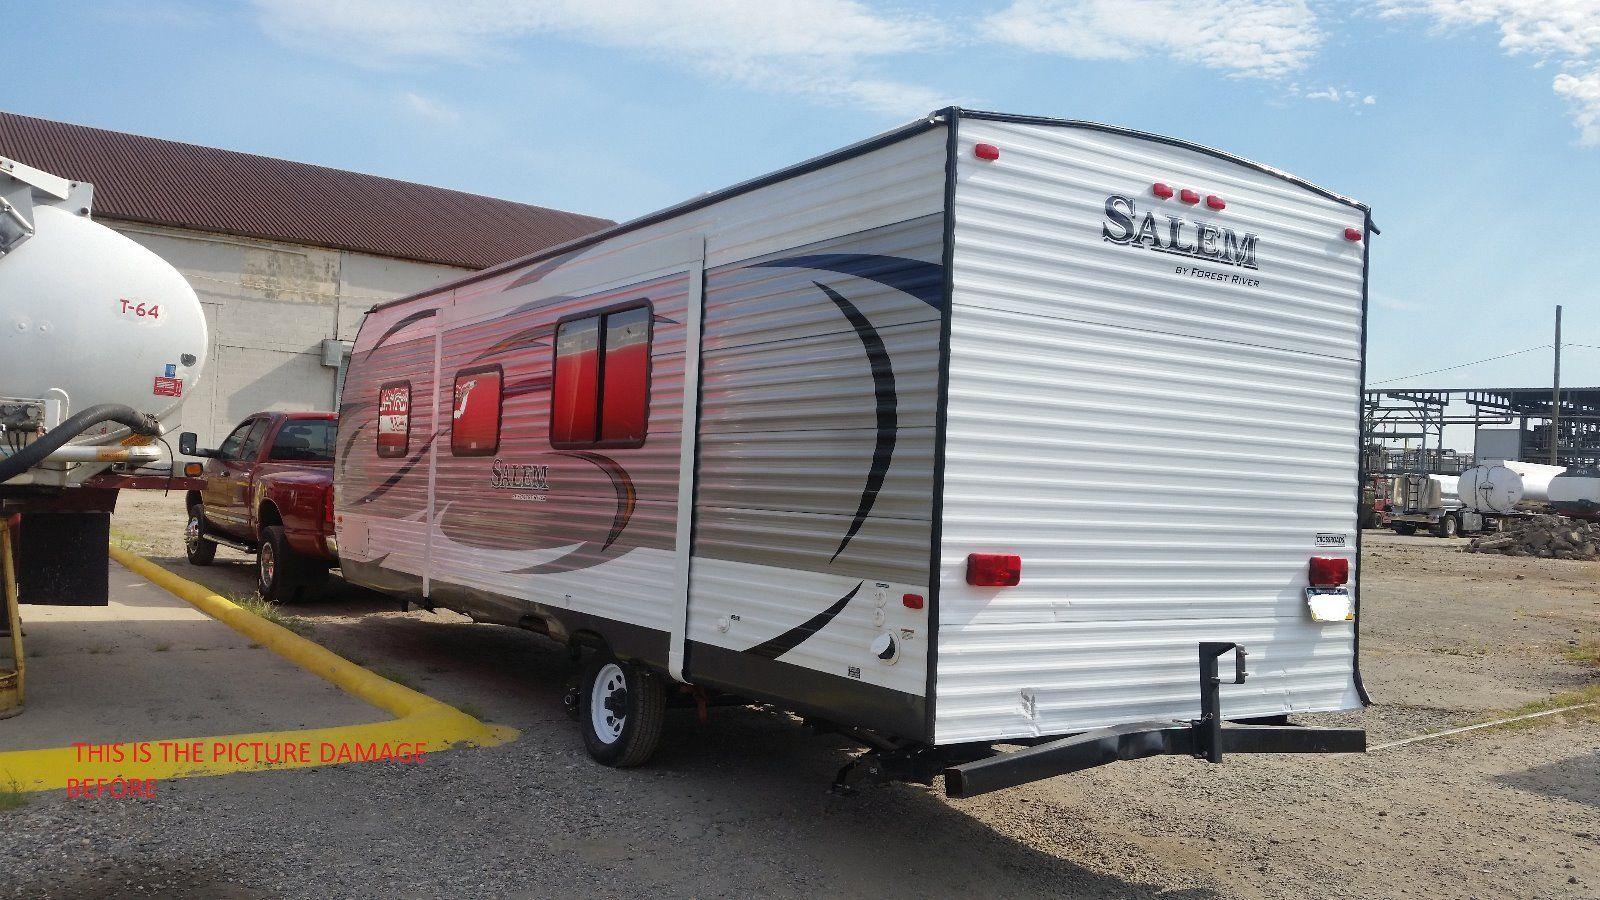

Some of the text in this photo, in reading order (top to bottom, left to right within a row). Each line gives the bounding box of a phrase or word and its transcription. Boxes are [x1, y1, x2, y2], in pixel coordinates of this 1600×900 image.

[1102, 194, 1259, 269] SALEM
[1175, 266, 1260, 288] BY FOREST RIVER
[119, 299, 159, 319] T-64
